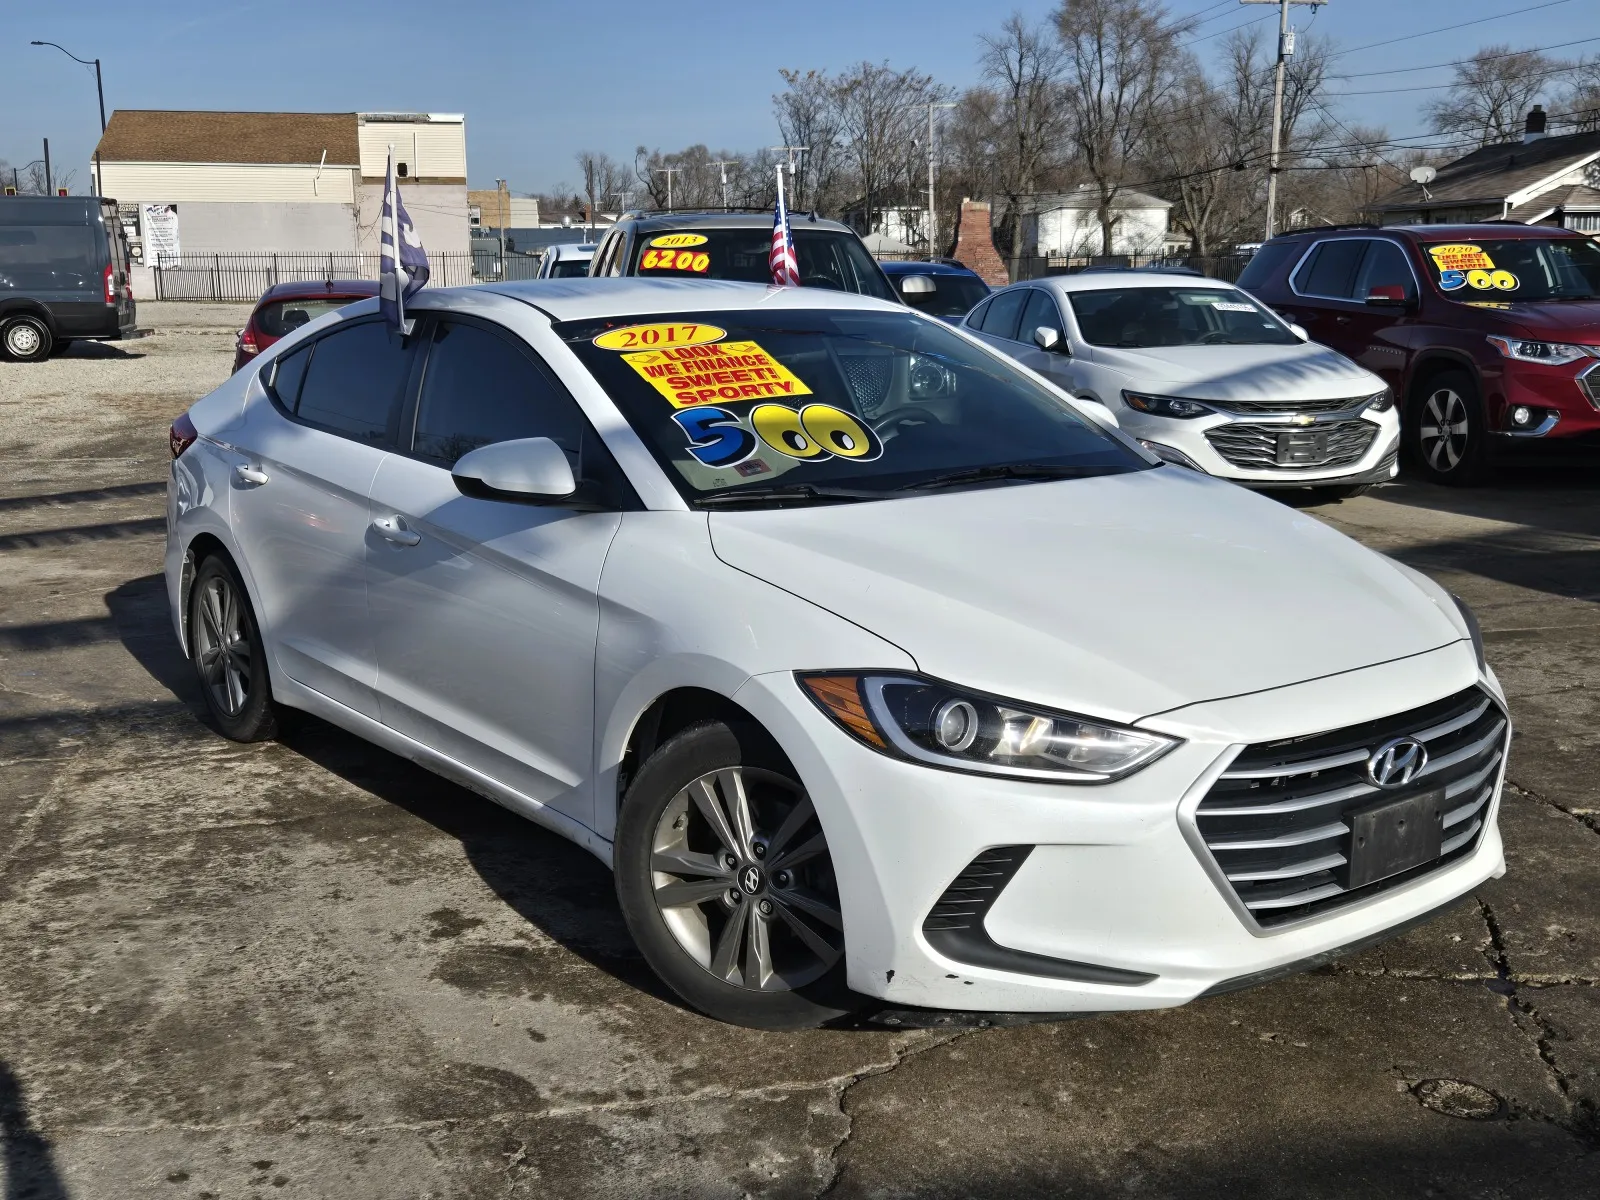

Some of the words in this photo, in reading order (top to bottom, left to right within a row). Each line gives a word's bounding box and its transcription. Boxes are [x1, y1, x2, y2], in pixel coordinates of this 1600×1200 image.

[661, 236, 698, 246] 2013
[642, 250, 710, 272] 6200
[1439, 269, 1520, 291] 500
[619, 325, 699, 348] 2017
[660, 344, 728, 361] LOOK
[642, 362, 681, 378] WE
[682, 354, 771, 374] FINANCE
[666, 367, 780, 391] SWEET!
[676, 381, 794, 405] SPORTY
[671, 403, 883, 469] 500
